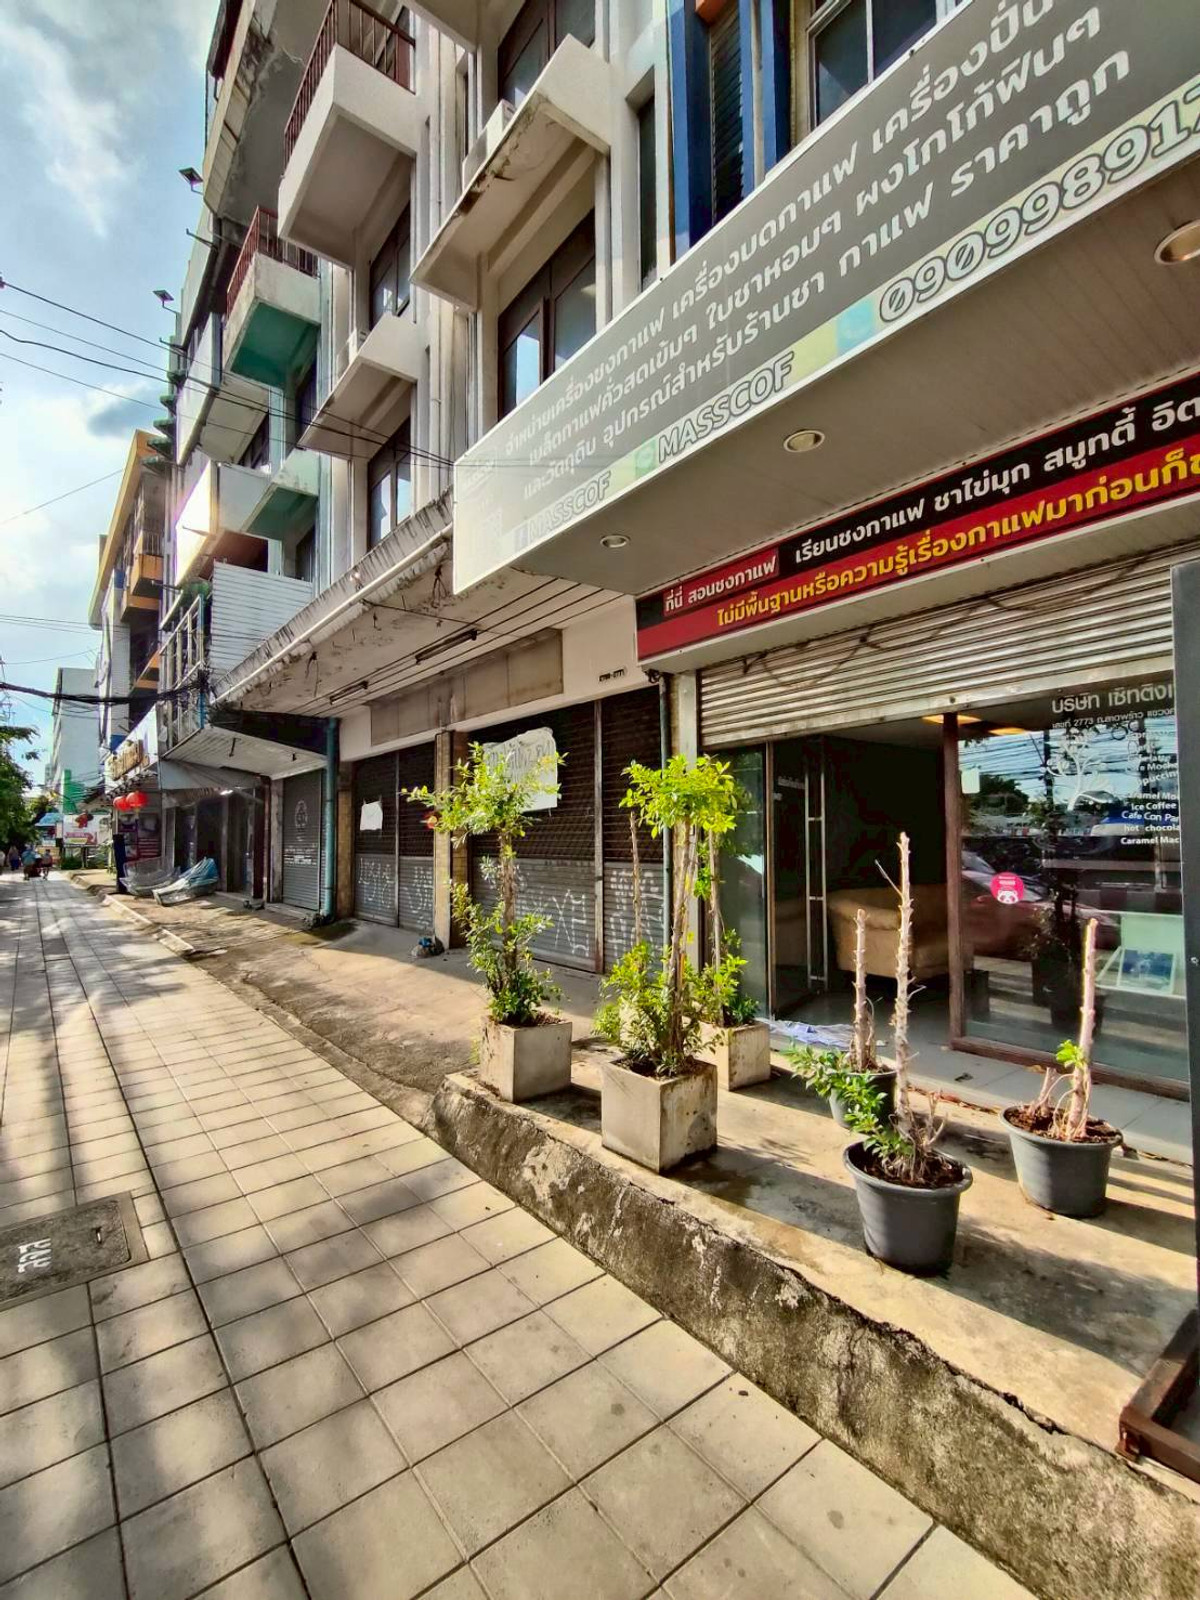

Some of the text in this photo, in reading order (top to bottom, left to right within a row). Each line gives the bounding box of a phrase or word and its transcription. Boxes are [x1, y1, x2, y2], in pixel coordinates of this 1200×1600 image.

[602, 271, 825, 448] อุปกรณ์สำหรับร้านชา
[839, 182, 934, 277] กาแฟ
[950, 50, 1130, 198] ราคาถูก
[706, 210, 842, 331] ใบชาหอมๆ
[856, 7, 1100, 217] ผงโกโก้ฟินๆ
[505, 306, 664, 455] จำหน่ายเครื่องชงกาแฟ
[672, 140, 858, 319] เครื่องบดกาแฟ
[528, 471, 611, 544] MASSCOF
[659, 350, 794, 463] MASSCOF
[665, 585, 683, 612] ที่นี่
[688, 555, 776, 604] สอนชงกาแฟ
[796, 499, 924, 564] เรียนชงกาแฟ
[934, 462, 1030, 512] ชาไข่มุก
[1043, 406, 1136, 472] สมูทตี้
[1052, 692, 1100, 713] บริษัท
[1121, 836, 1159, 845] Caramel
[1145, 801, 1177, 810] Coffee
